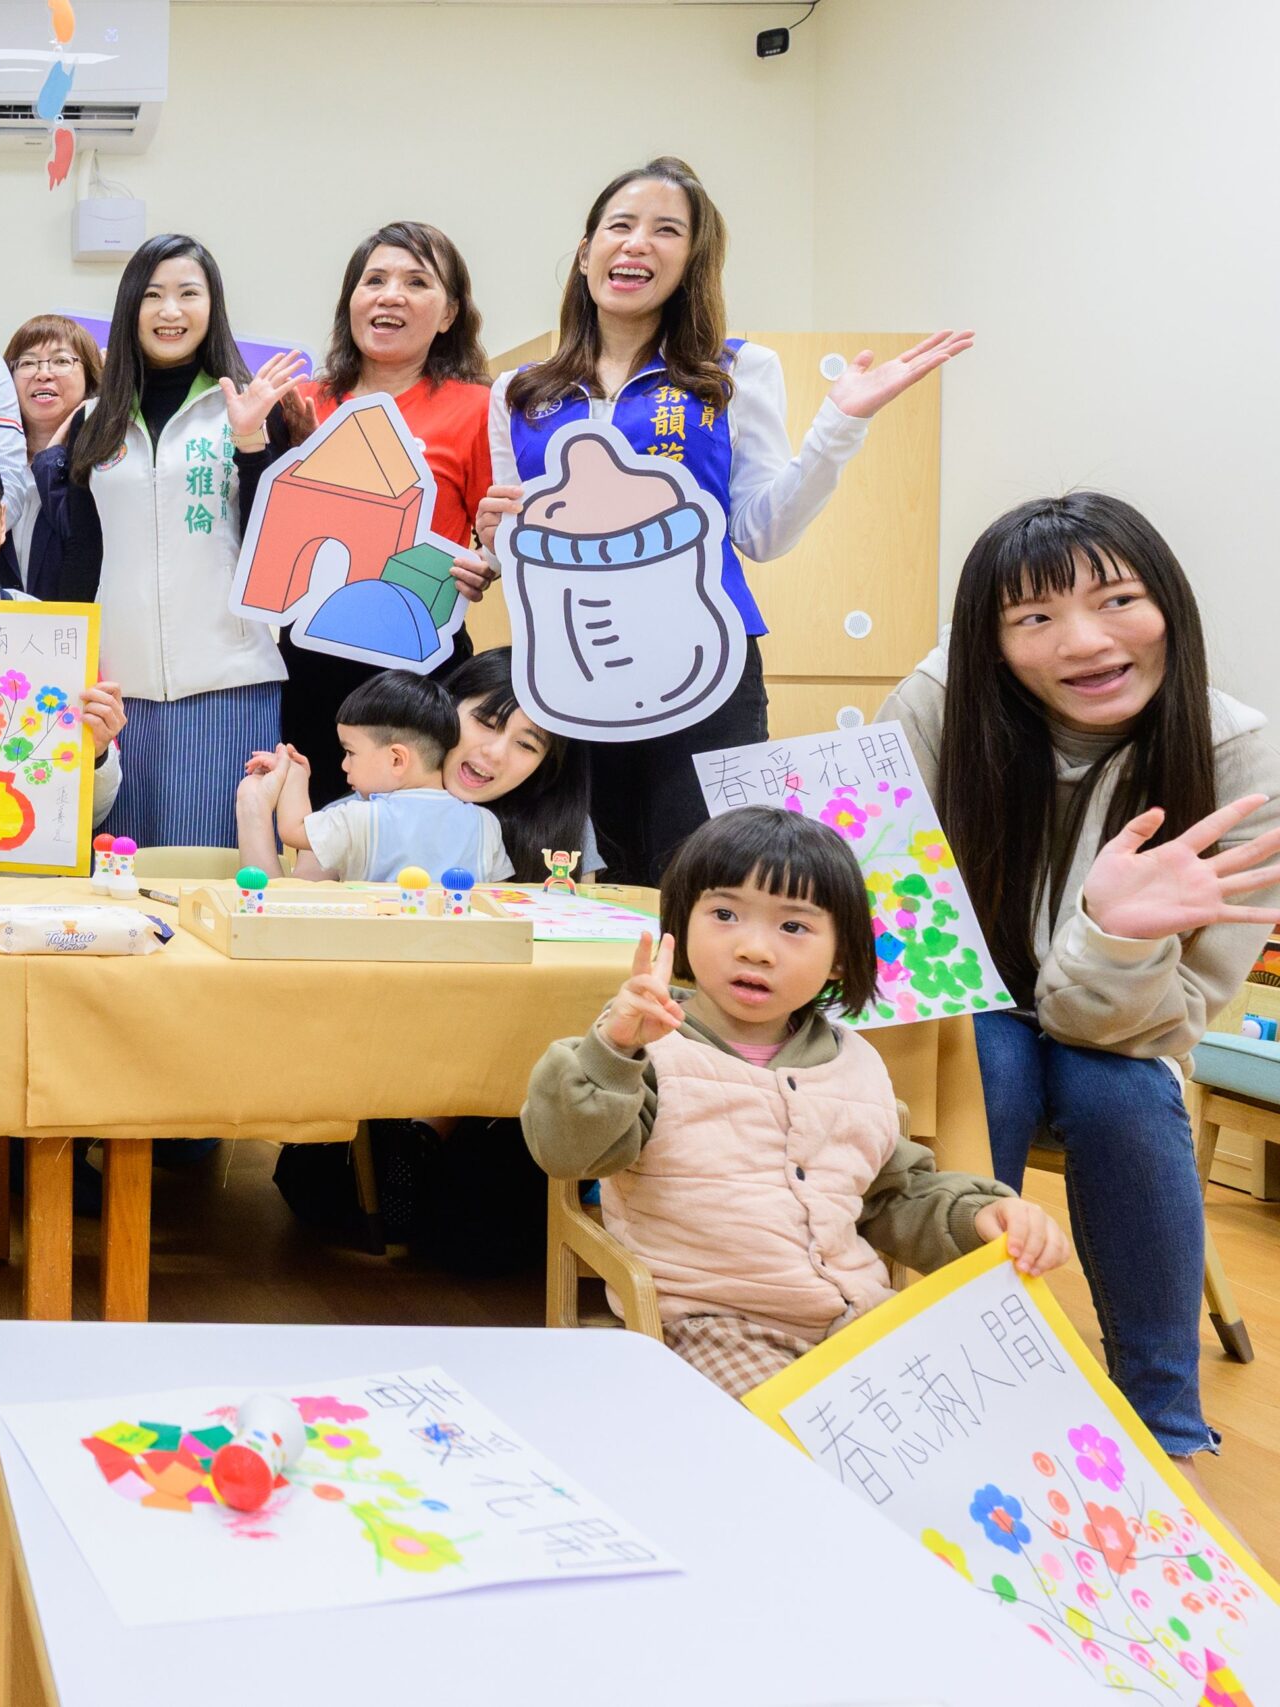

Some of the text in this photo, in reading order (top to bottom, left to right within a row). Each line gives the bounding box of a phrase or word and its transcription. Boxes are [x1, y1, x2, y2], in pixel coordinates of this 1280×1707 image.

[184, 436, 219, 535] 陳雅倫
[704, 732, 911, 808] 春暖花開
[806, 1293, 1066, 1505] 春意滿人間
